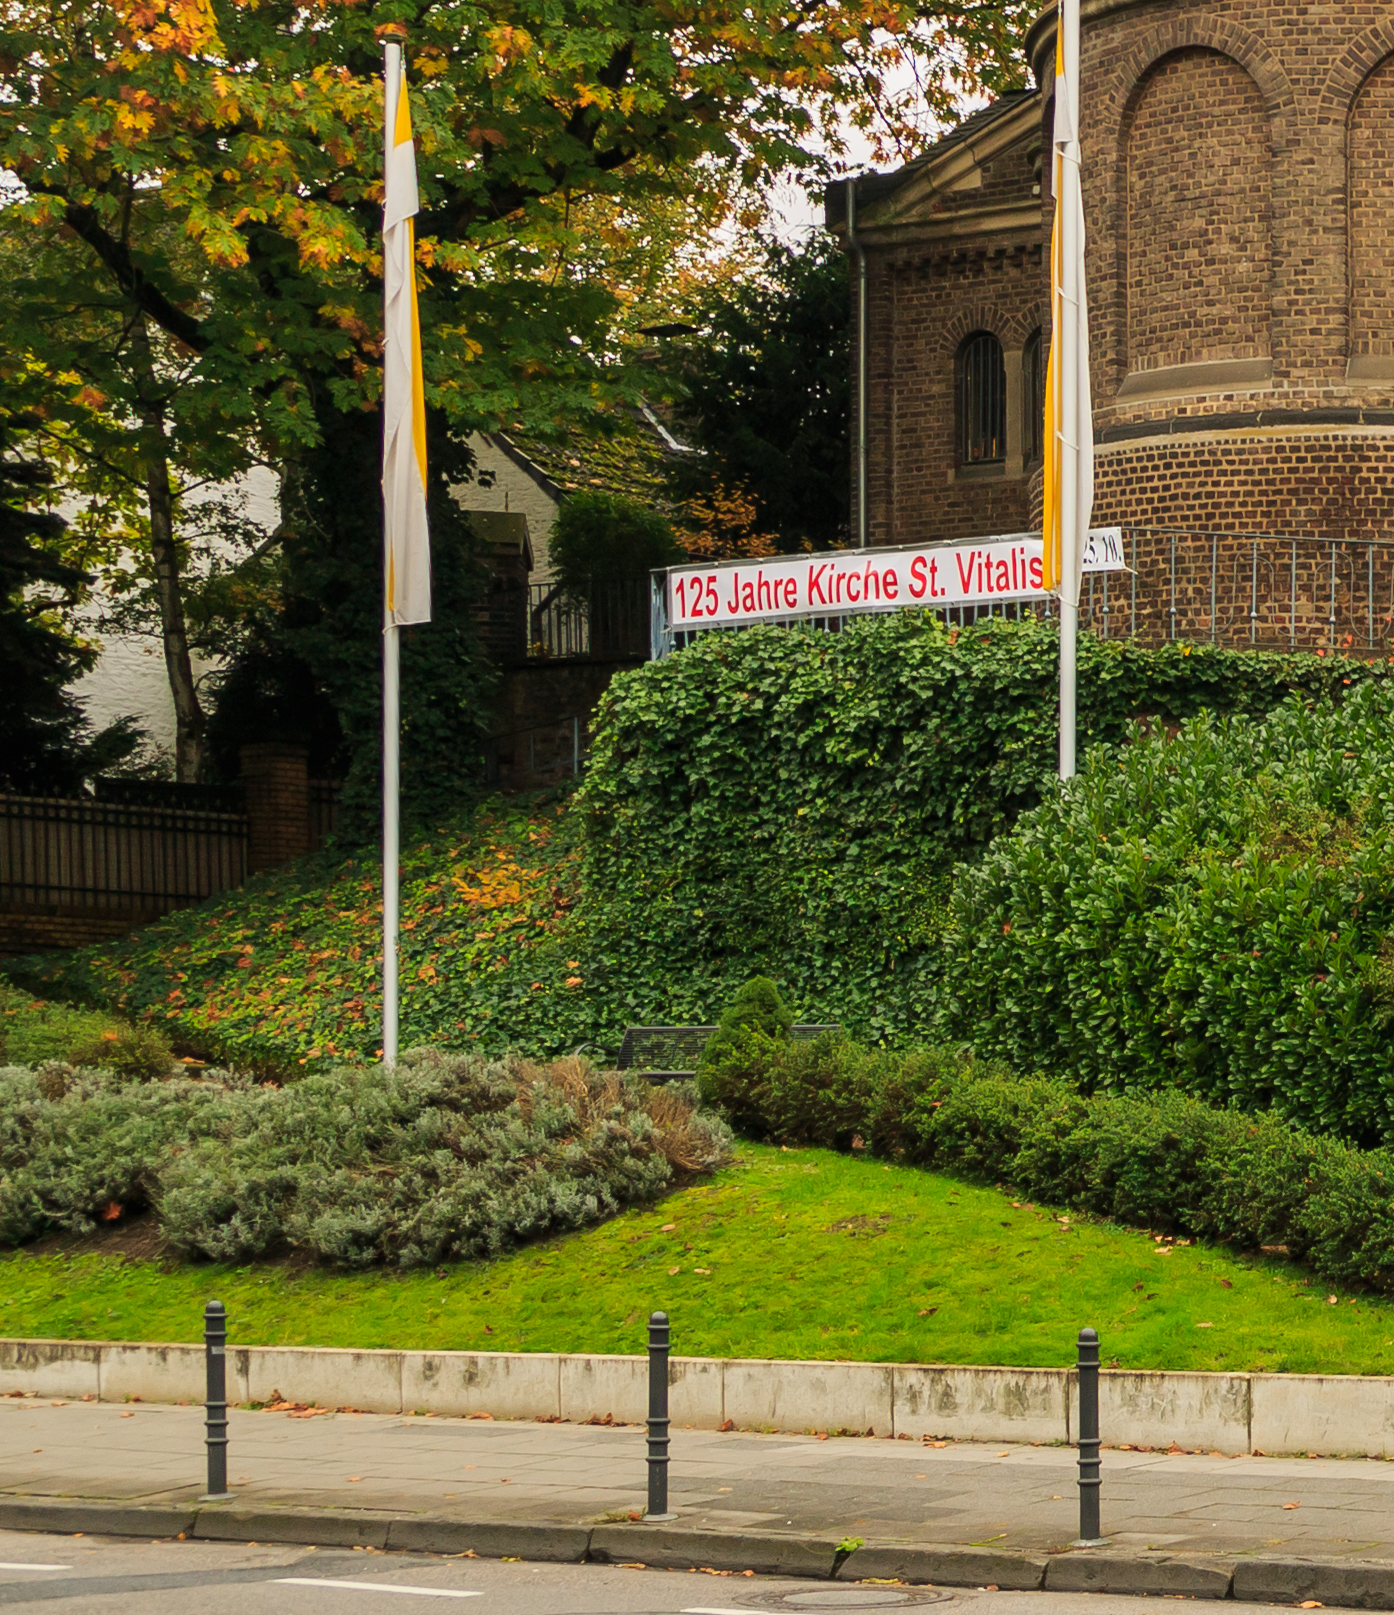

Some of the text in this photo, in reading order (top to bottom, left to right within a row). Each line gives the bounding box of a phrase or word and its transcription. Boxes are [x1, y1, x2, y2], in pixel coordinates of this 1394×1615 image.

[675, 546, 1043, 618] 125 Jahre Kirche St. Vitalis
